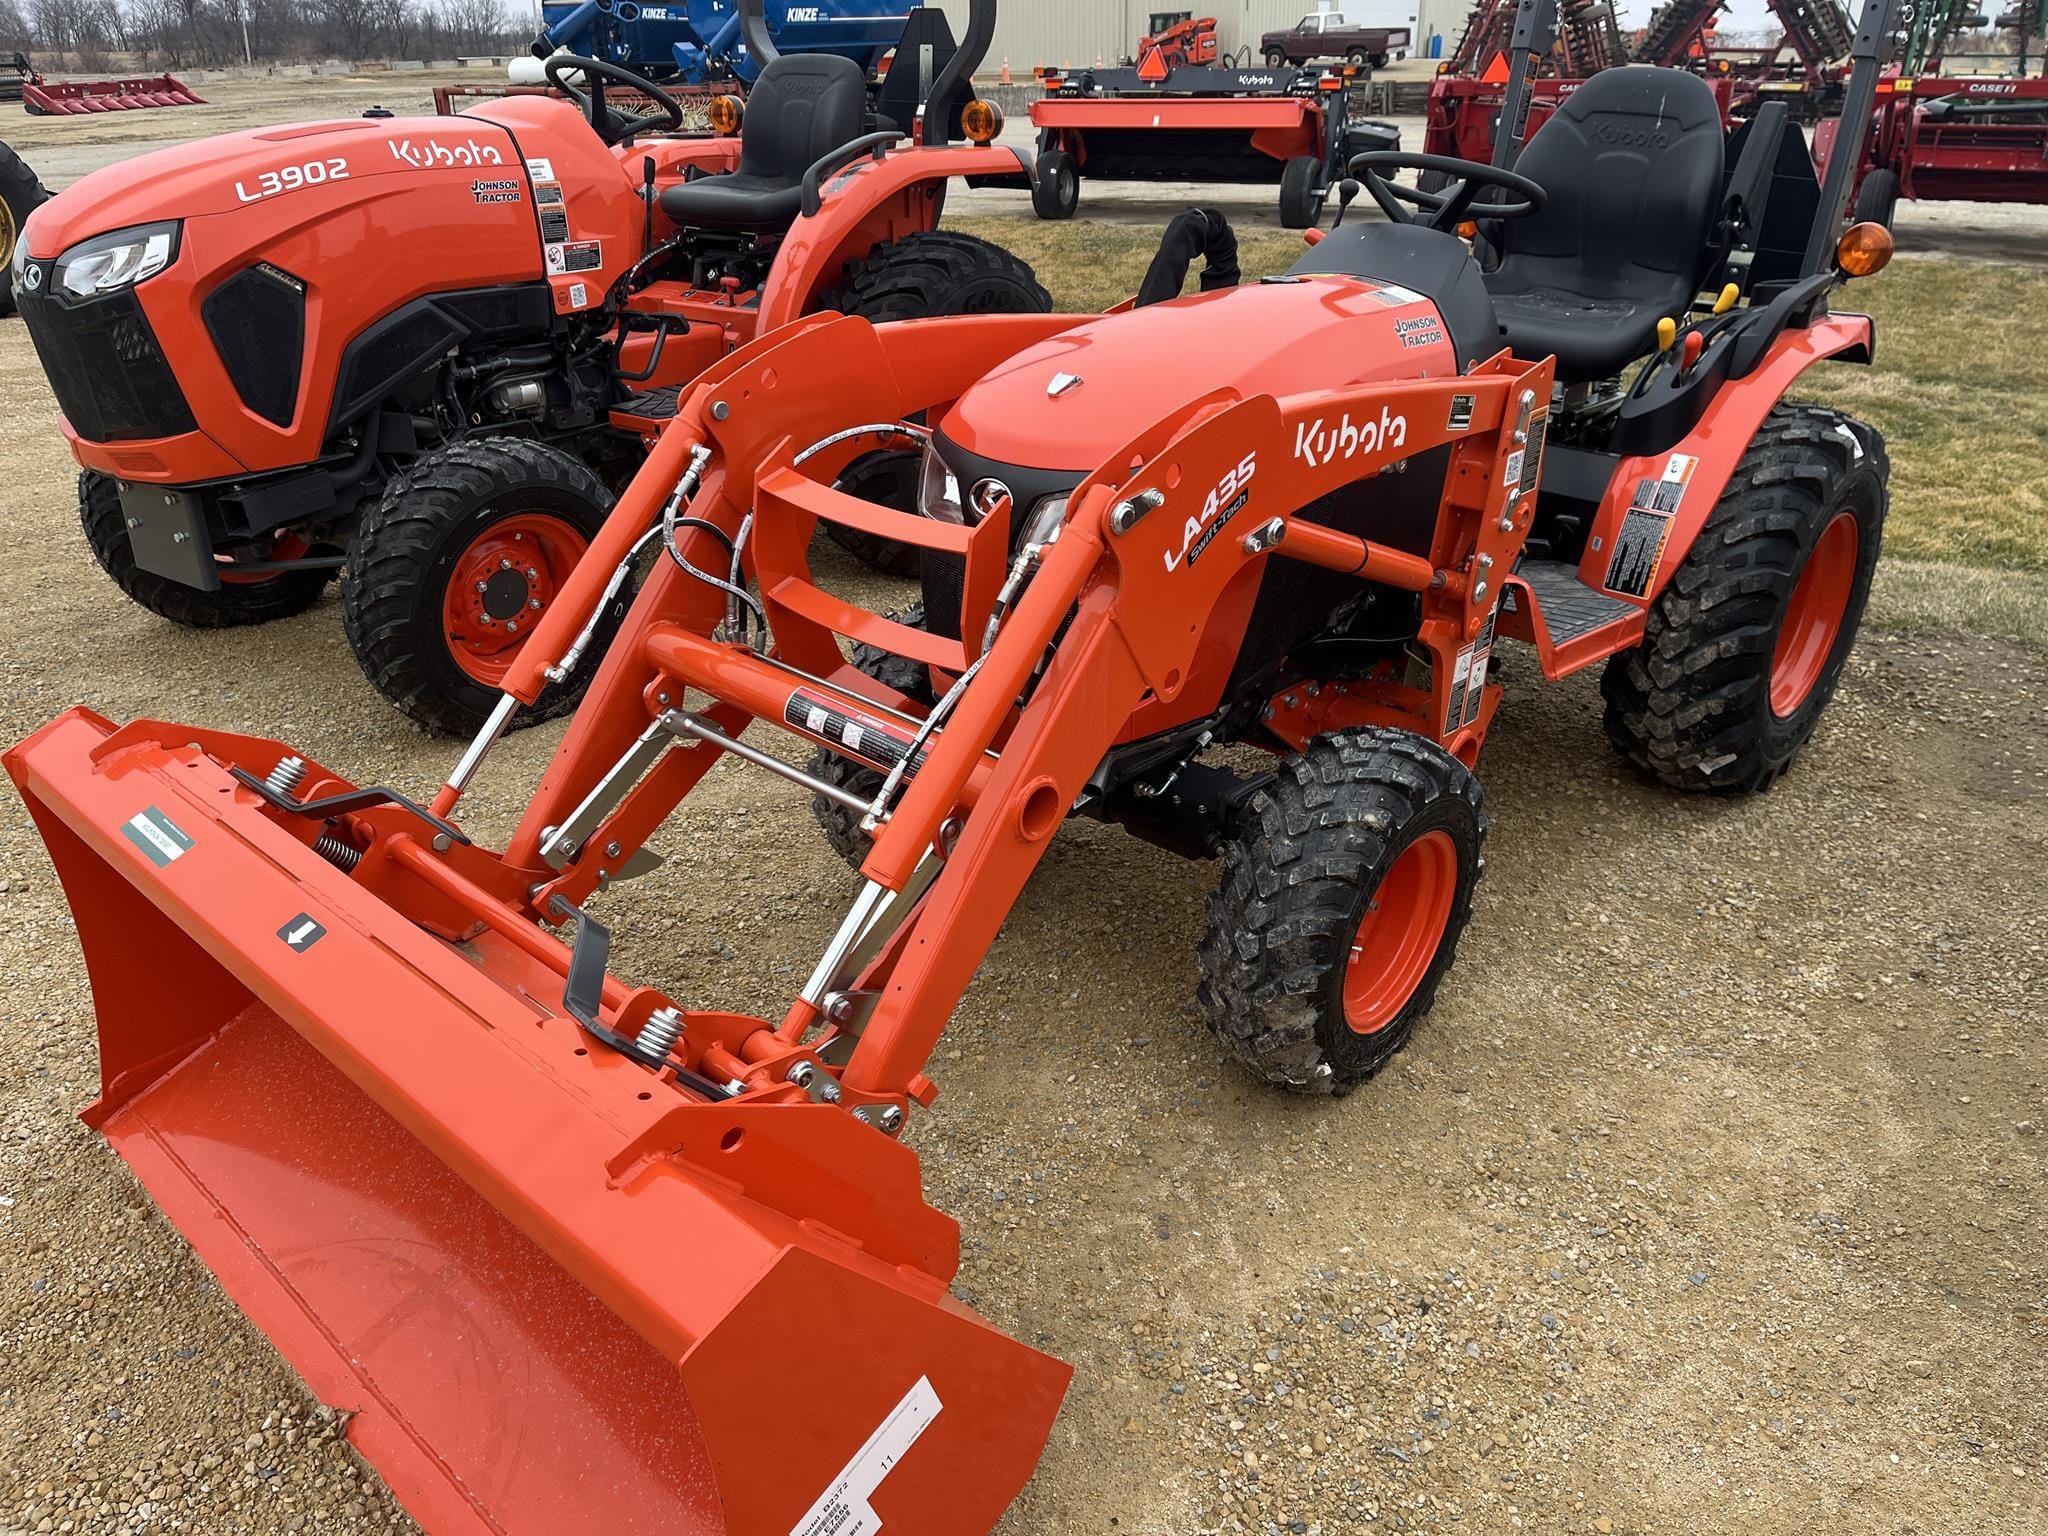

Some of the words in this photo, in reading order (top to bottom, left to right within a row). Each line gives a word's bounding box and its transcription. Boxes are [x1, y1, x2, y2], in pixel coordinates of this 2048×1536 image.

[641, 8, 667, 19] KINZE
[786, 7, 819, 22] KINZE
[1238, 75, 1274, 85] Kubota
[1969, 83, 2001, 93] CASE
[387, 138, 503, 168] Kubota
[234, 157, 350, 202] L3902
[471, 179, 518, 192] JOHNSON
[473, 191, 520, 204] TRACTOR
[1394, 316, 1438, 333] JOHNSON
[1399, 331, 1443, 348] TRACTOR
[1294, 405, 1407, 468] Kubota
[1162, 450, 1257, 574] LA435
[1189, 493, 1247, 562] Swift-Tach
